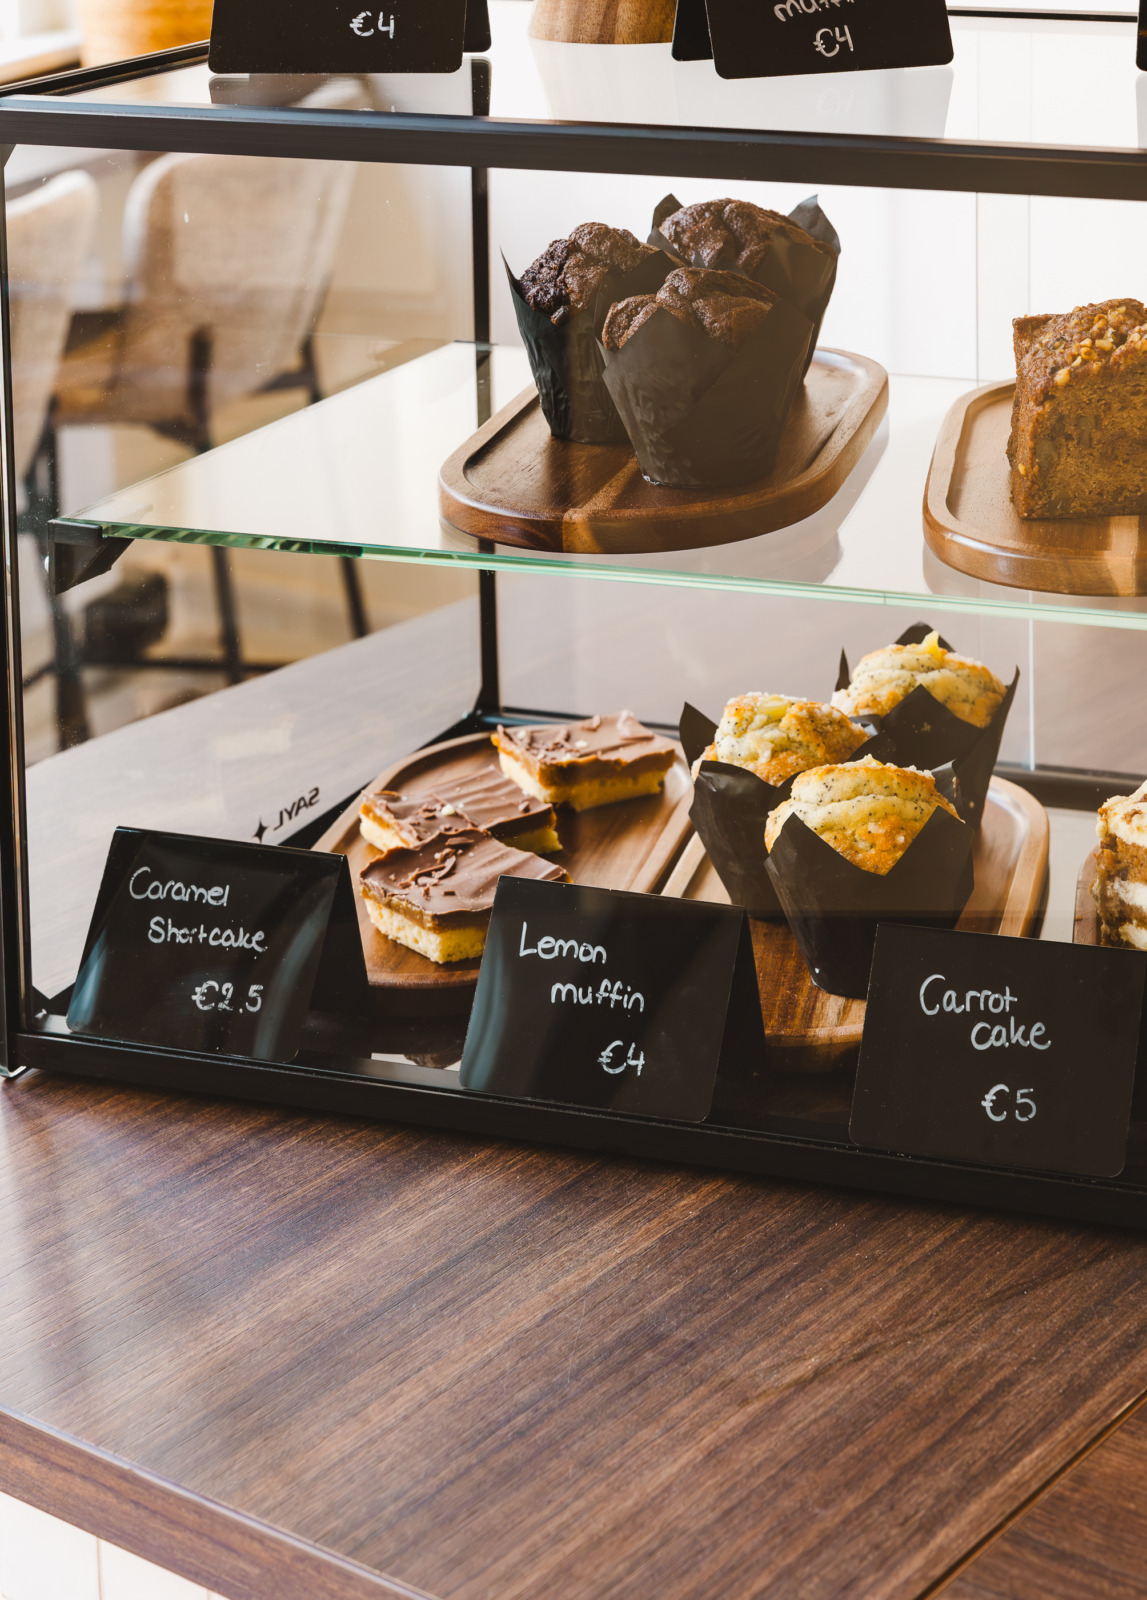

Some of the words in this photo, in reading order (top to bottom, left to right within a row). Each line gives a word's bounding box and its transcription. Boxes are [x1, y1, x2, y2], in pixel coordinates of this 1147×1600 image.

[349, 11, 395, 39] €4
[813, 25, 854, 57] €4
[129, 866, 230, 906] Caramel
[148, 916, 268, 952] Shortcake
[519, 921, 607, 964] Lemon
[191, 980, 264, 1013] €2.5
[551, 978, 645, 1012] muffin
[919, 973, 1018, 1016] Carrot
[970, 1015, 1052, 1050] cake
[597, 1040, 645, 1077] €4
[981, 1083, 1037, 1122] €5
